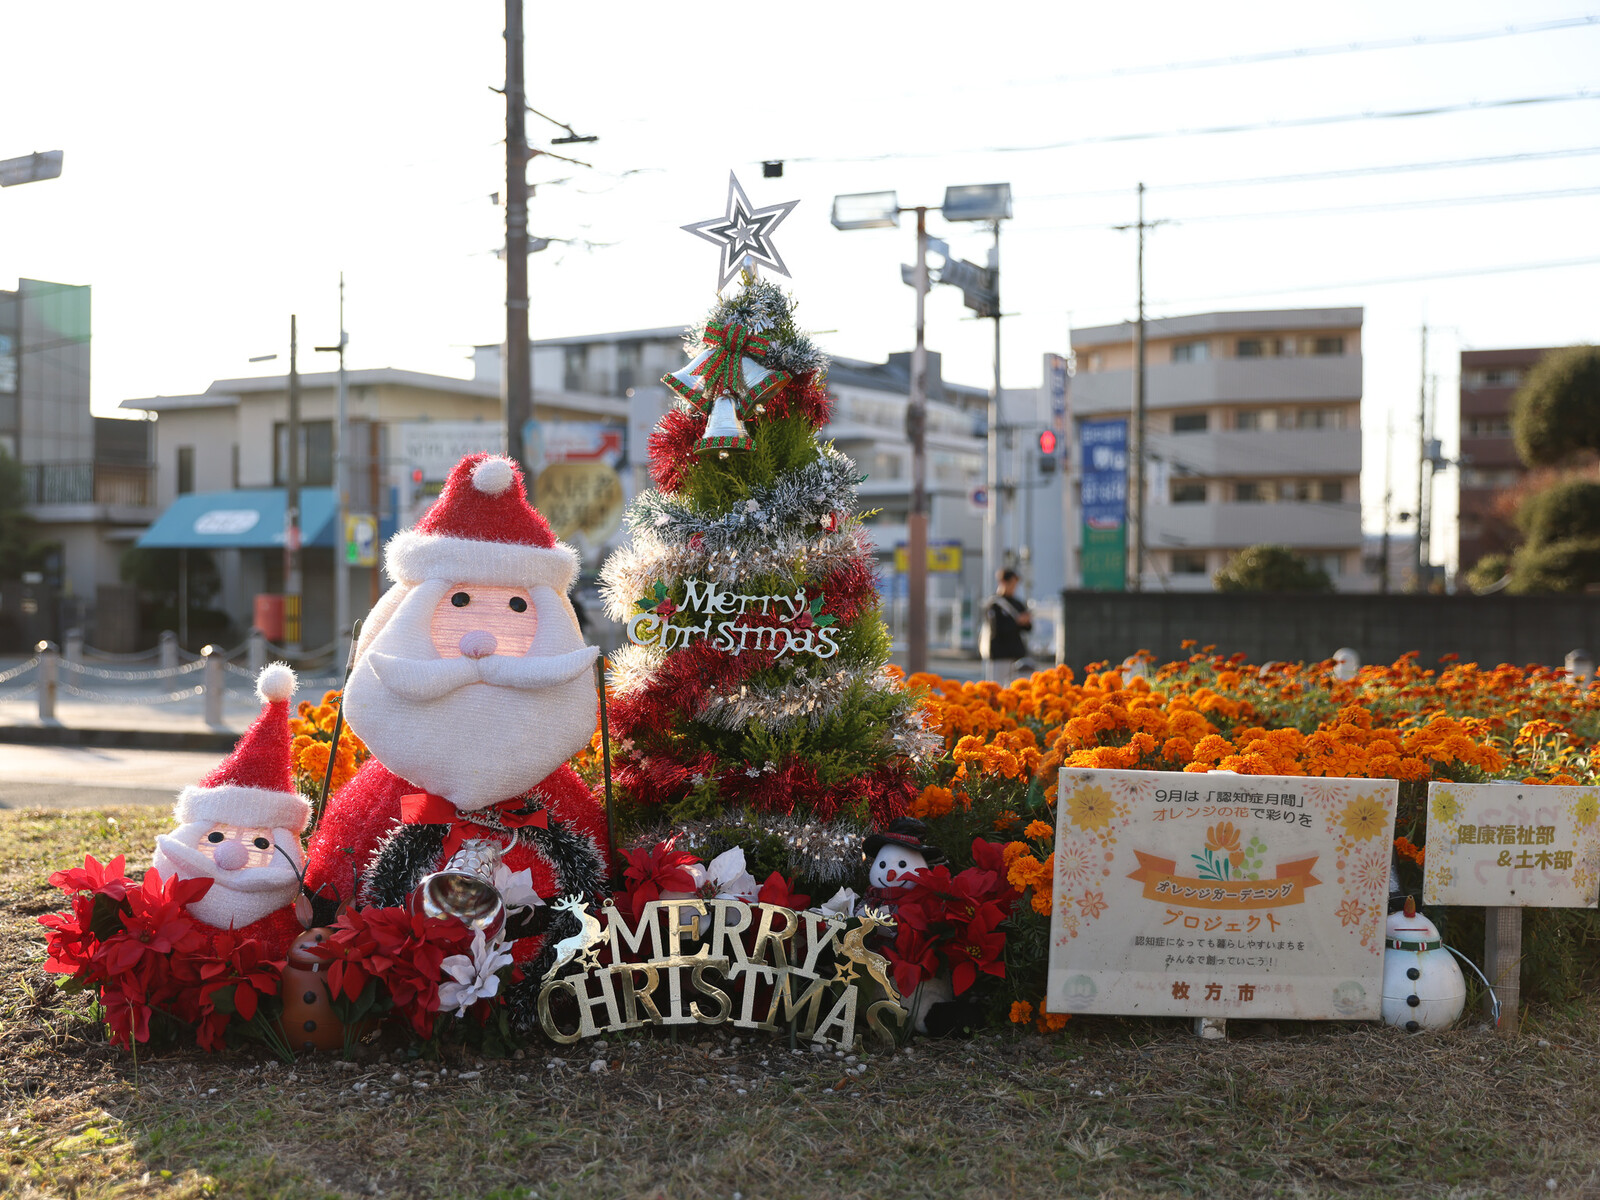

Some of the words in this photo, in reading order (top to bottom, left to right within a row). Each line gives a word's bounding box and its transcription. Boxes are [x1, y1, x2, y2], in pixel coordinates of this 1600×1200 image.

[677, 576, 806, 624] Merry
[627, 612, 841, 660] Christmas
[1152, 805, 1313, 829] オレンジの花で彩りを
[1456, 823, 1556, 846] 健康福祉部
[1155, 881, 1295, 902] オレンジガーデニング
[1162, 908, 1282, 934] プロジェクト
[602, 898, 847, 980] MERRY
[1134, 935, 1306, 952] 認知症になっても暮らしやすいまちを
[1171, 980, 1257, 1002] 枚方市
[537, 957, 908, 1057] CHRISTMAS
